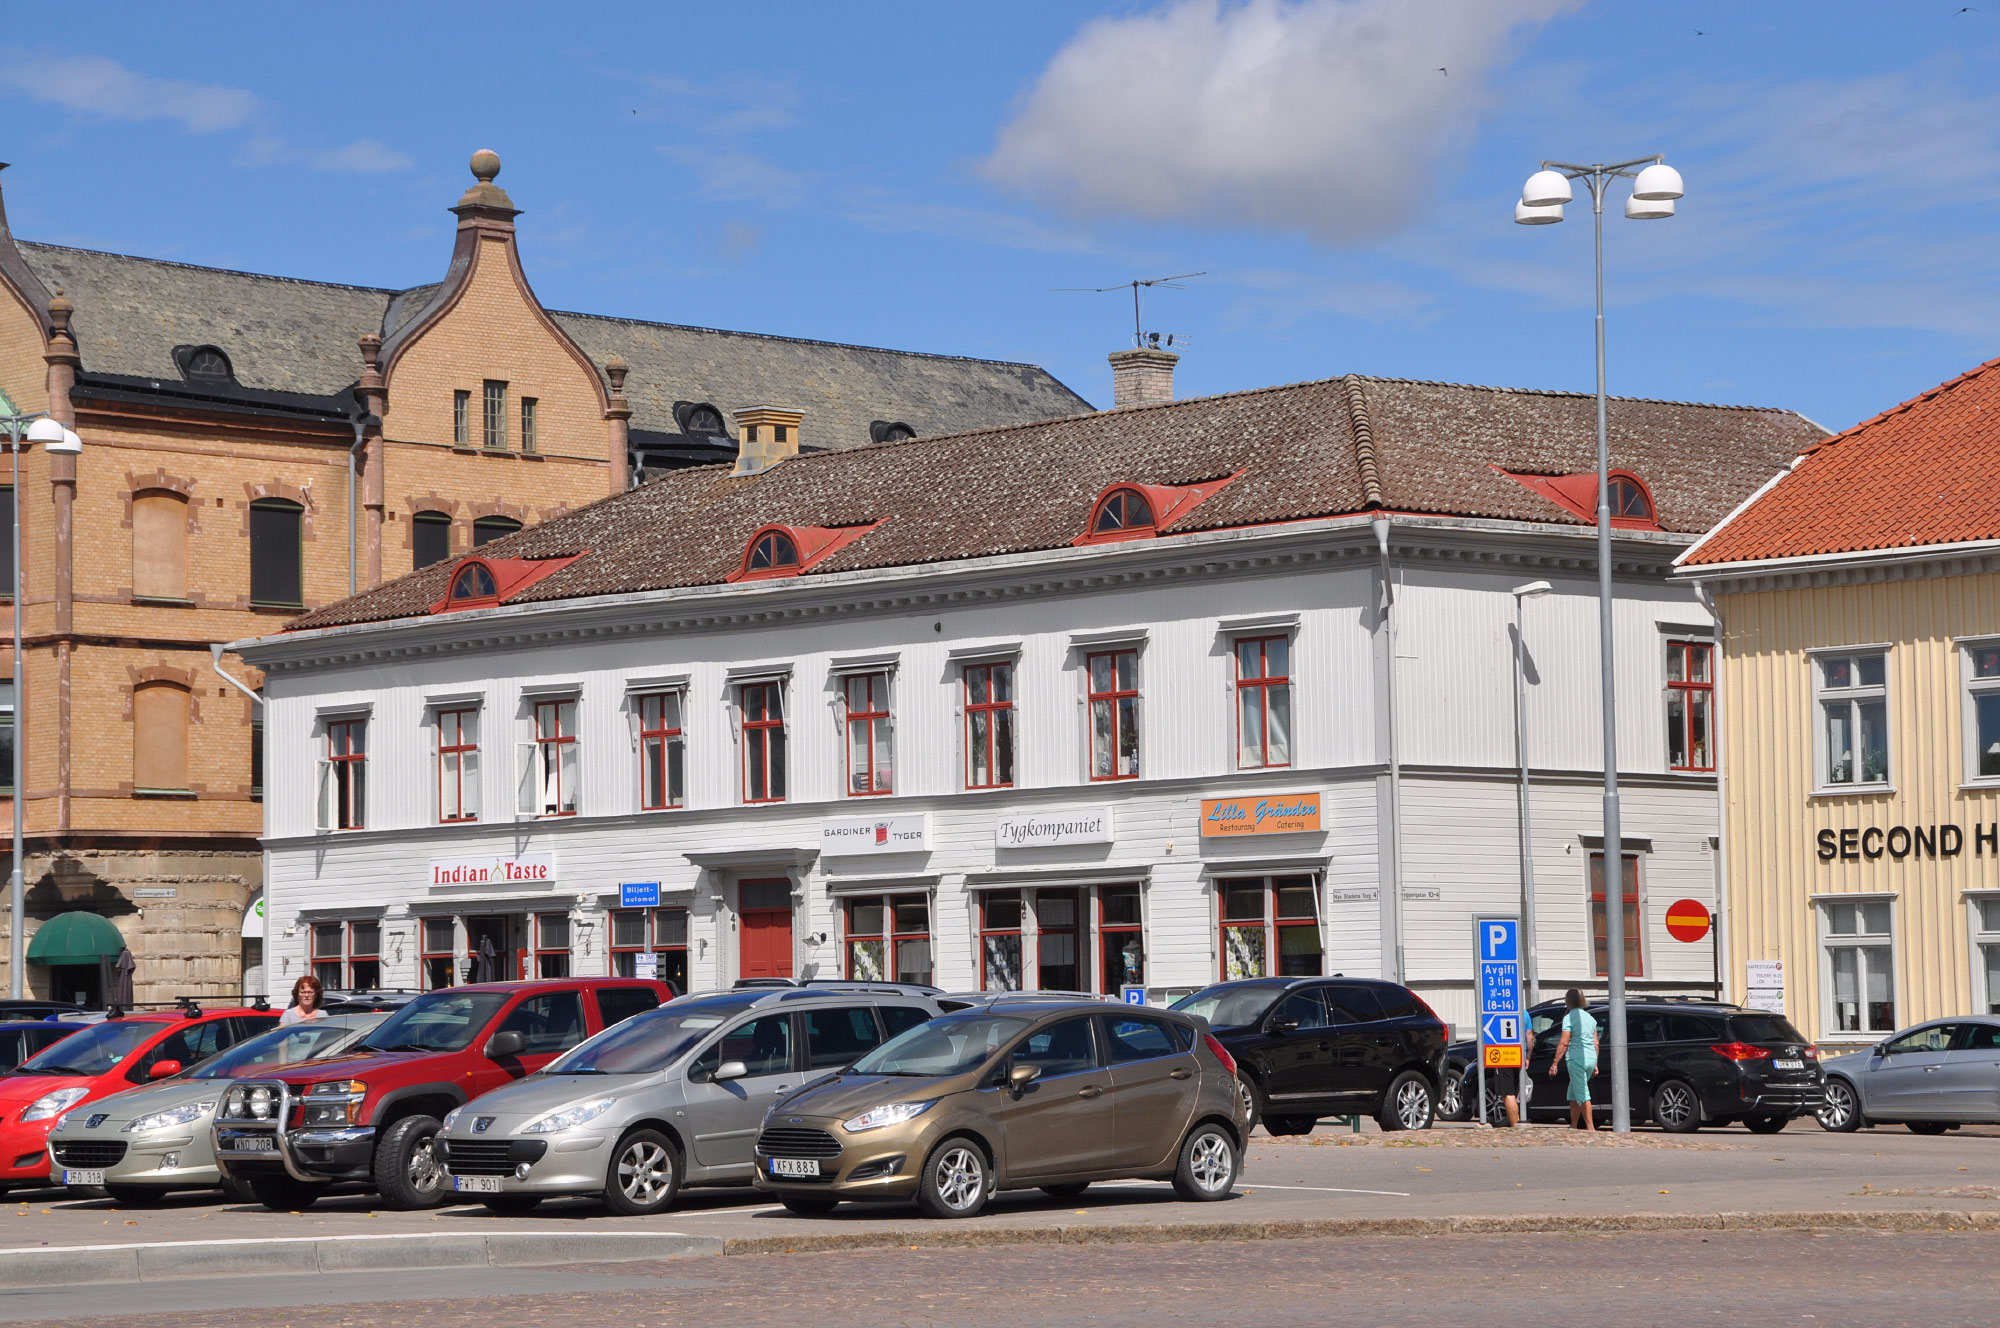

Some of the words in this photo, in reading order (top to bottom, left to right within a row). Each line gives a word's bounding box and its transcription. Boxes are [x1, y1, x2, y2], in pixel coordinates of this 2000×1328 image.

[1207, 802, 1246, 821] Lilla
[1254, 799, 1317, 824] Gränden
[824, 827, 871, 837] GARDINER
[892, 831, 922, 840] TYGER
[1000, 817, 1103, 844] Tygkompaniet
[1219, 823, 1256, 833] Restaurang
[1276, 820, 1305, 830] Catering
[1817, 824, 1963, 861] SECOND
[1975, 822, 1998, 855] H
[434, 864, 489, 884] Indian
[504, 861, 547, 880] Taste
[1489, 925, 1507, 957] P
[1485, 964, 1515, 976] Avgift
[1488, 976, 1495, 987] 3
[1497, 975, 1513, 987] tim
[1129, 991, 1139, 1005] P
[1487, 999, 1515, 1010] (8-14)
[255, 1138, 272, 1150] 208
[776, 1160, 794, 1173] XFX
[796, 1160, 815, 1174] 883
[87, 1171, 102, 1183] 318
[459, 1177, 475, 1190] FWT
[480, 1178, 497, 1191] 901
